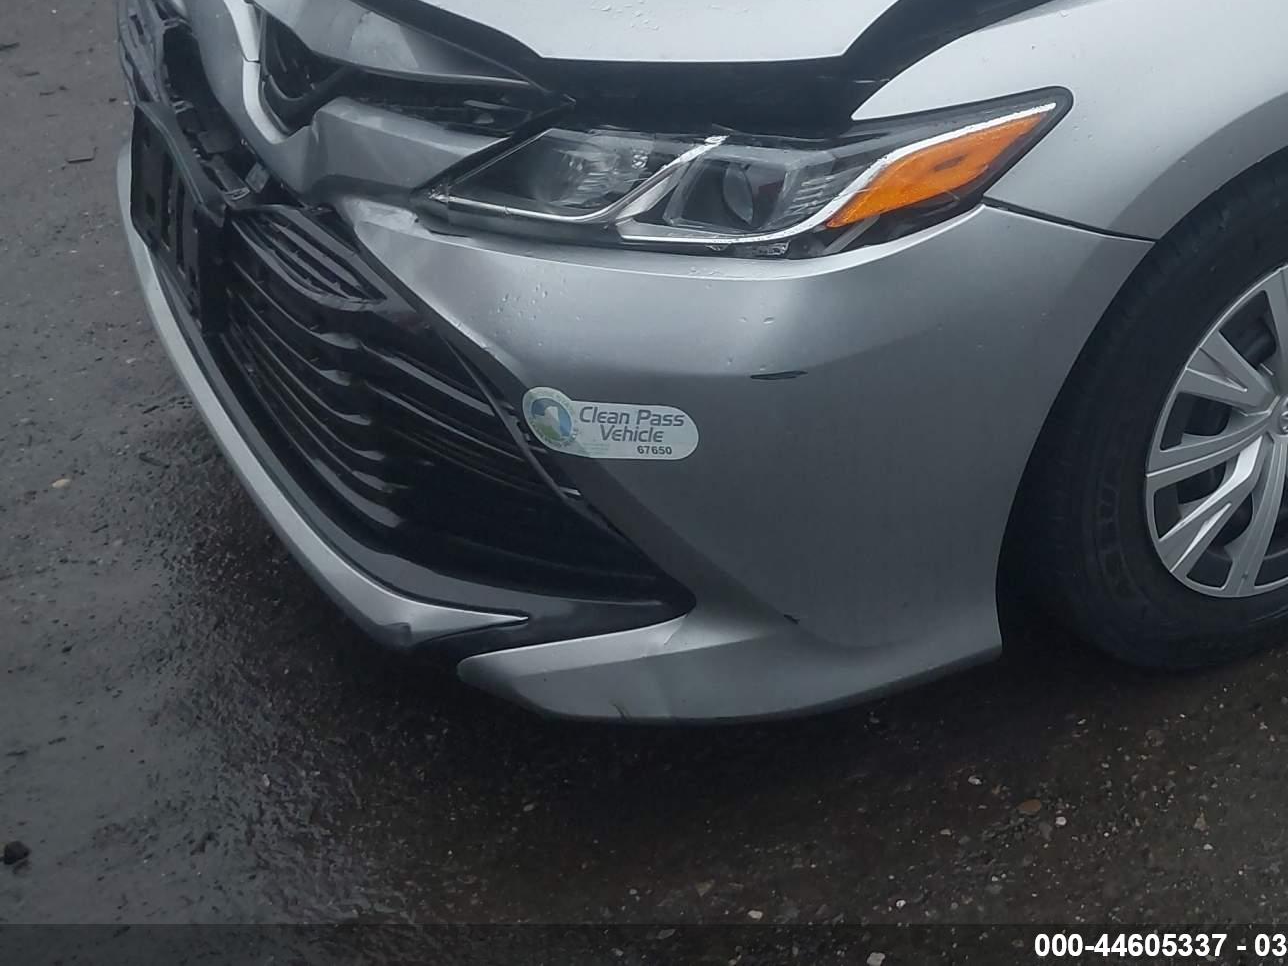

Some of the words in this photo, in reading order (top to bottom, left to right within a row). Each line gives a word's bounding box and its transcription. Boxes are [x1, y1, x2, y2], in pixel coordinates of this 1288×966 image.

[579, 406, 630, 425] Clean
[637, 409, 685, 427] Pass
[600, 425, 665, 443] Vehicle
[637, 445, 673, 455] 67650
